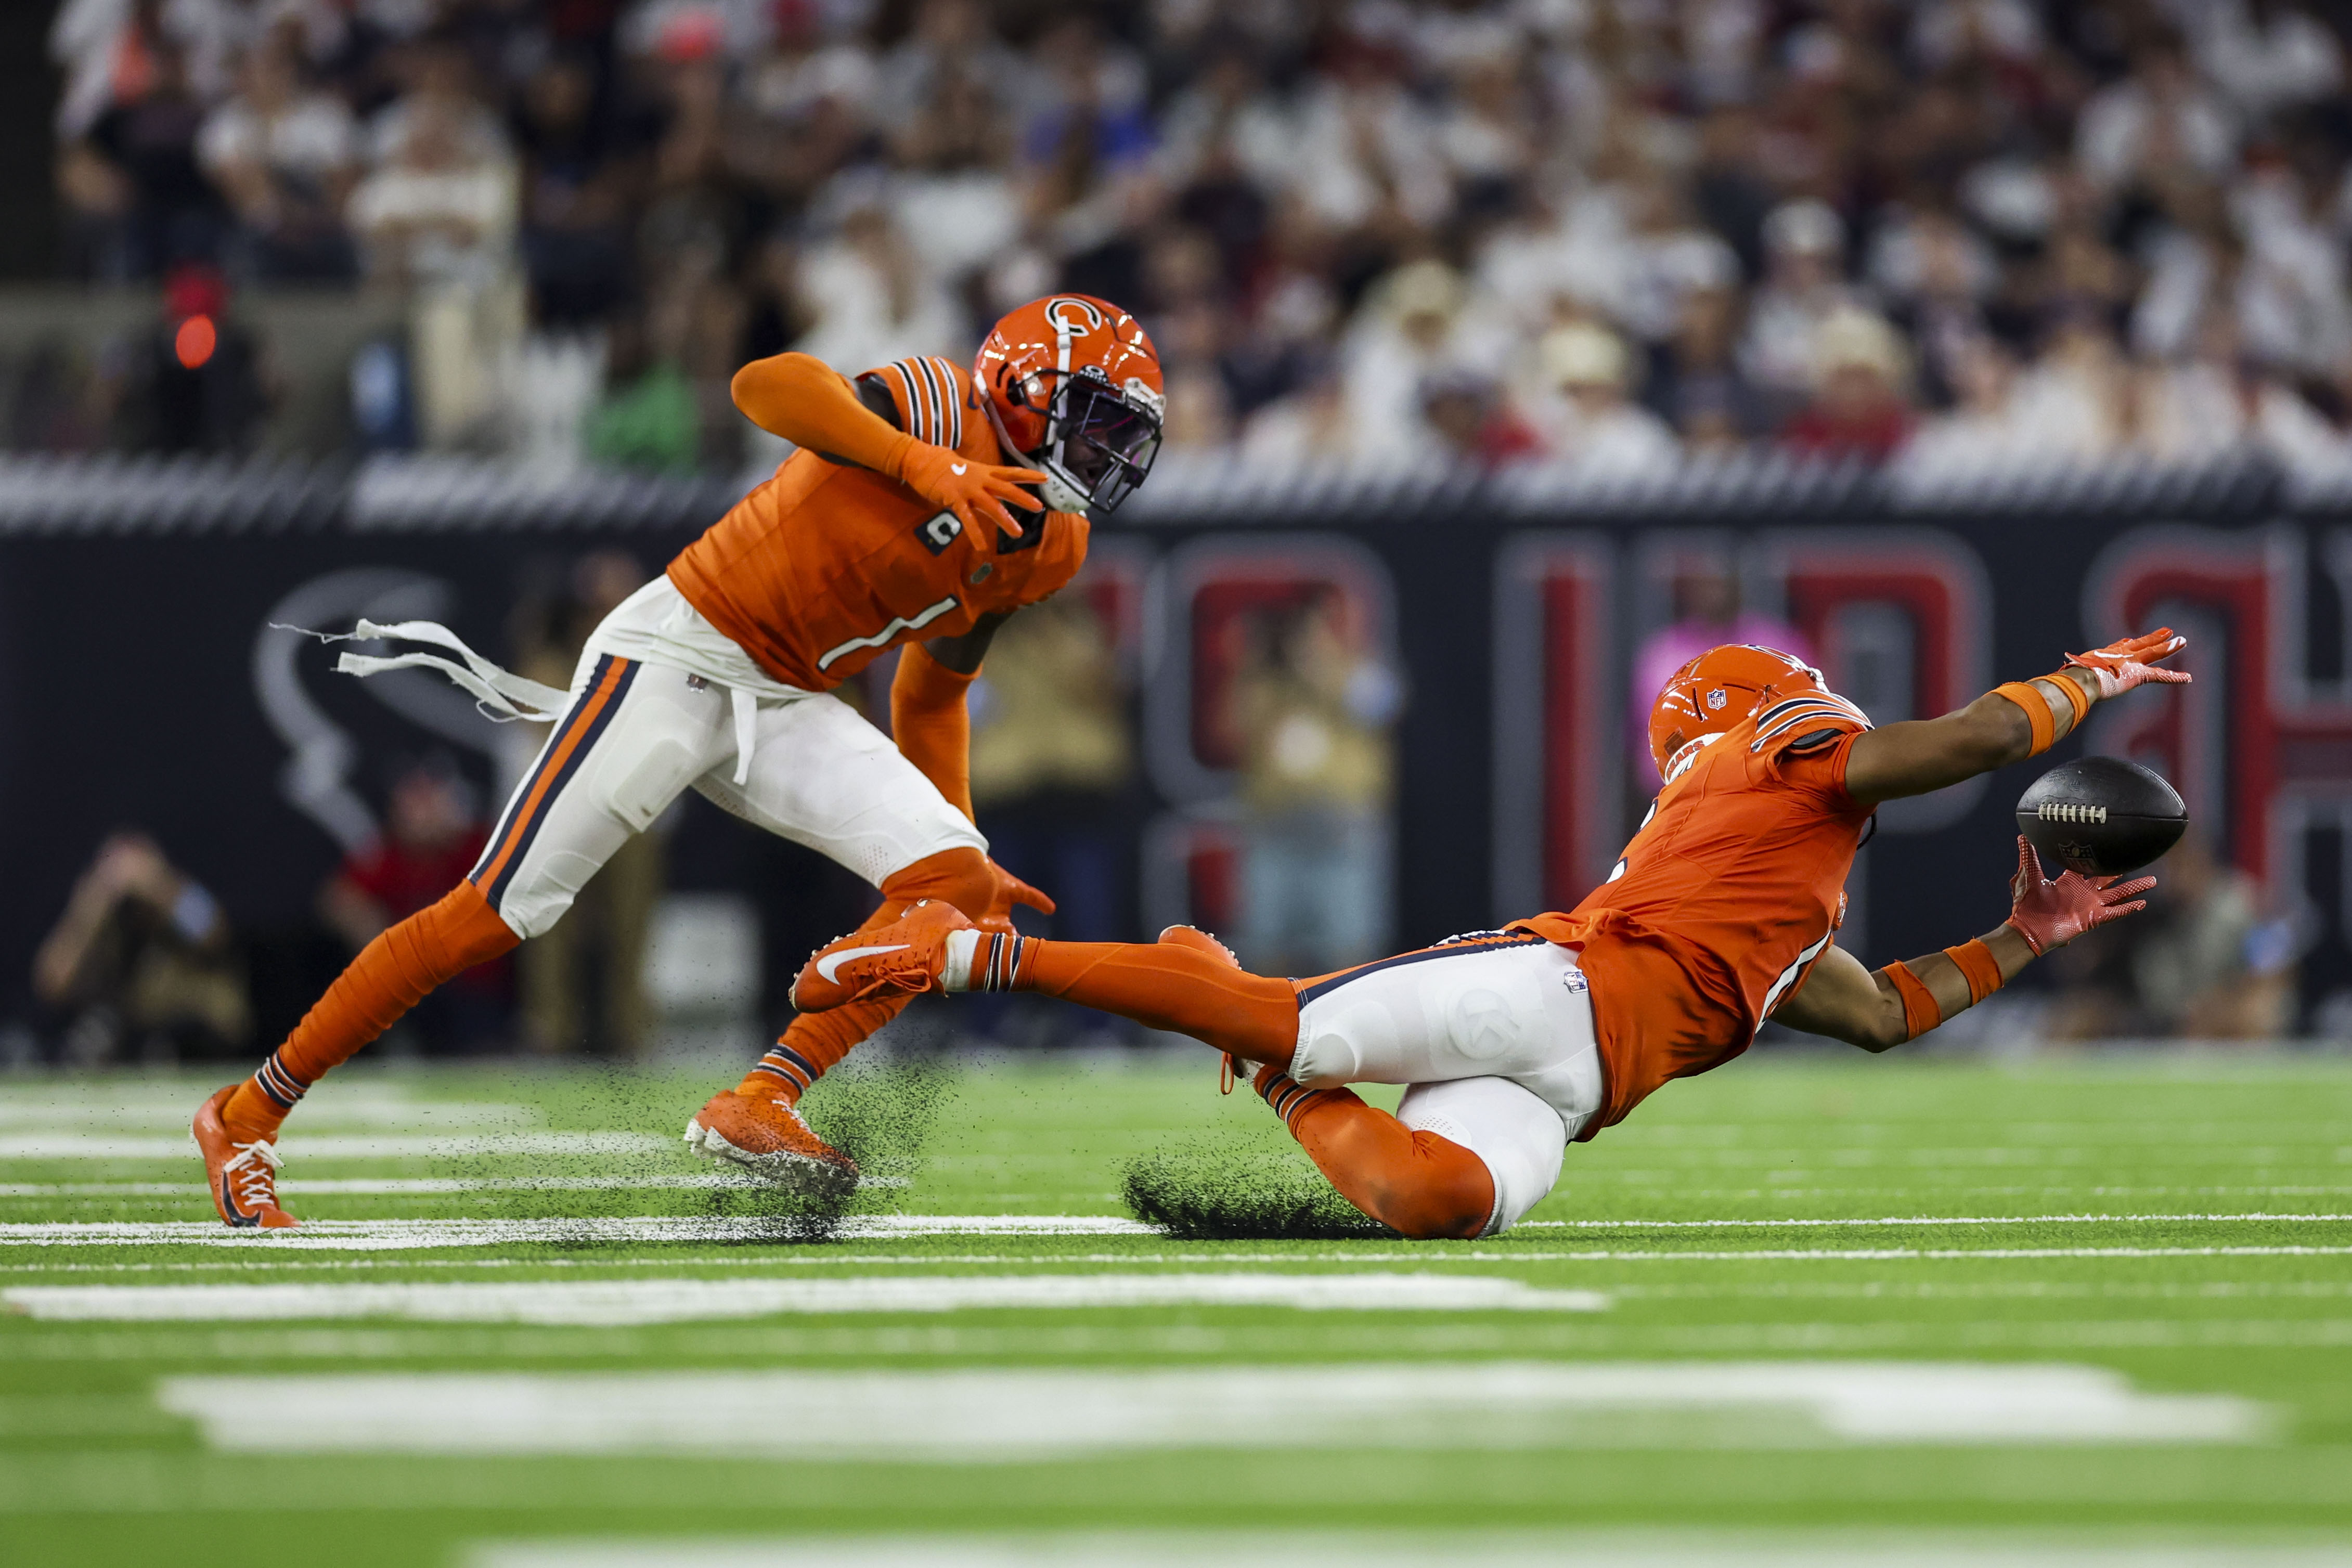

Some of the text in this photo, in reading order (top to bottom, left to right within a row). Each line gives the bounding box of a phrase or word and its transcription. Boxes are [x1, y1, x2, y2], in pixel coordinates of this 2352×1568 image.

[926, 512, 961, 546] C
[817, 593, 961, 674] 1
[1711, 698, 1724, 706] NFL
